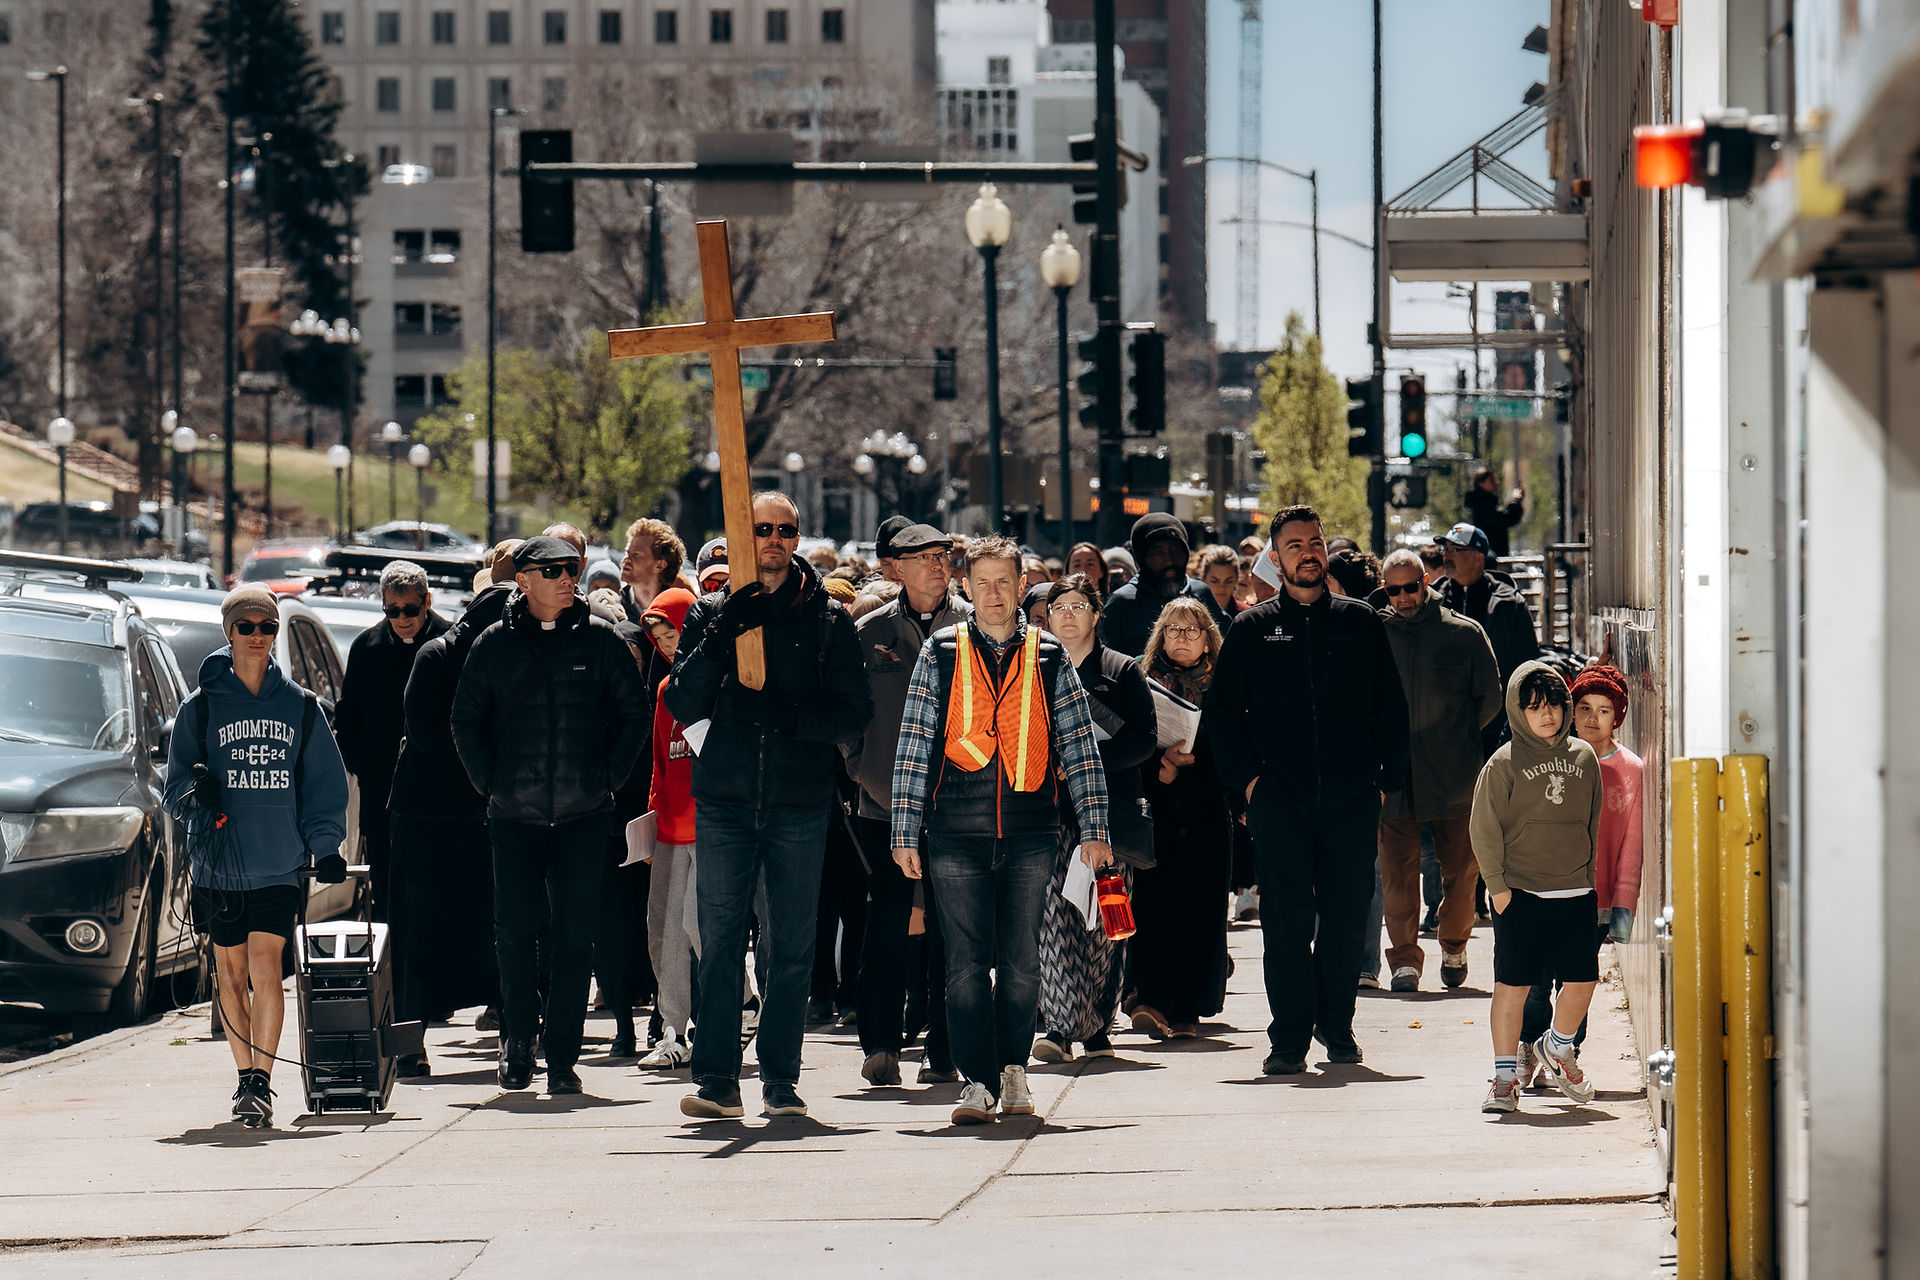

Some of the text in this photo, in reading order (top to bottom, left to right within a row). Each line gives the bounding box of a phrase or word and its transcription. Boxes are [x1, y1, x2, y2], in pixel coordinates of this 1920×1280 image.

[218, 719, 295, 747] BROOMFIELD
[231, 748, 245, 760] 20
[270, 748, 286, 760] 24
[227, 769, 289, 789] EAGLES
[1521, 756, 1584, 780] brooklyn
